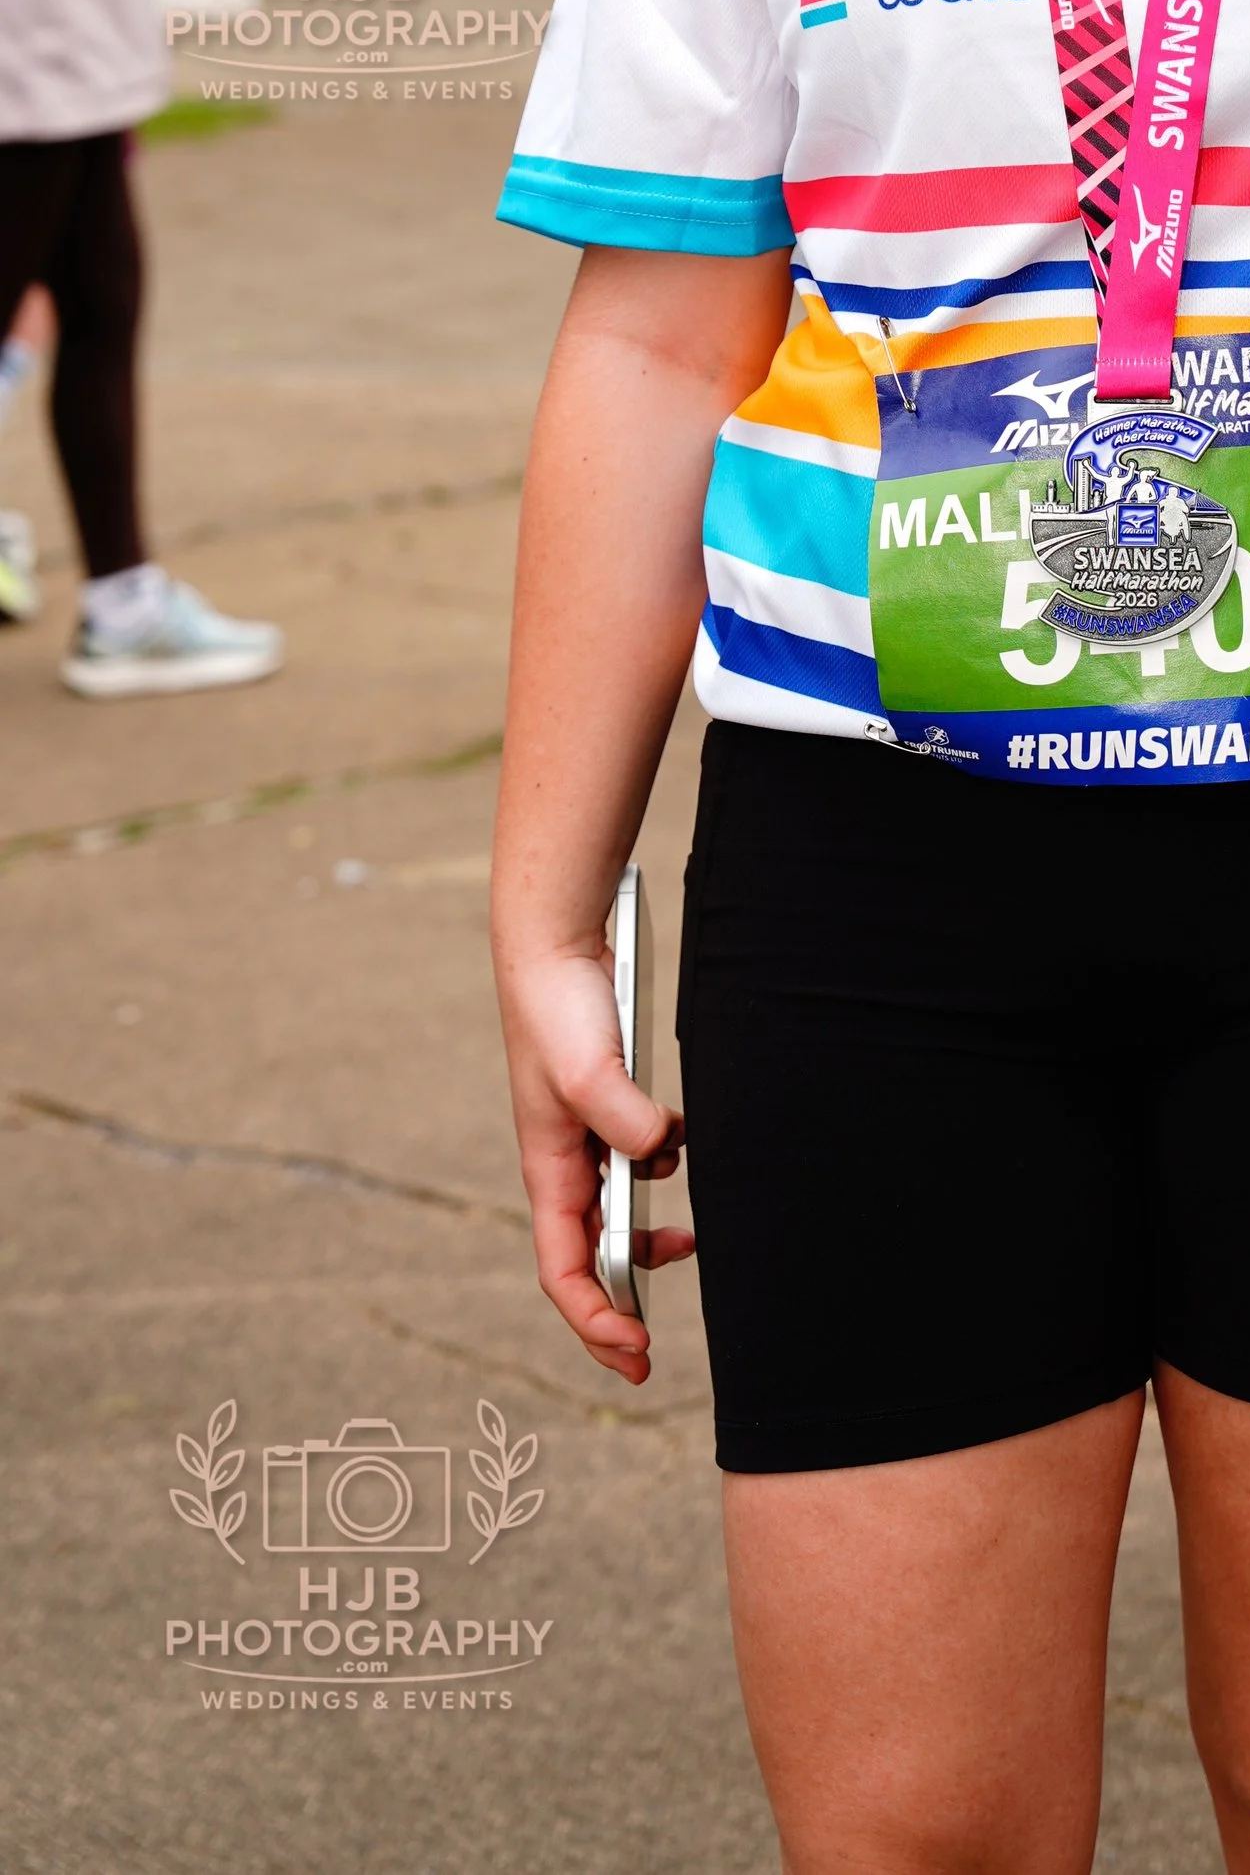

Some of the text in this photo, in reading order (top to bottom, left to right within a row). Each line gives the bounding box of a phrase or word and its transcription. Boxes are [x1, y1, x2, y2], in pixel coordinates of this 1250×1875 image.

[1095, 418, 1199, 443] Hanner Marathon
[1114, 432, 1175, 447] Abertawe
[1074, 547, 1202, 572] SWANSEA
[1115, 592, 1158, 608] 2026
[1054, 595, 1197, 636] #RUNSWANSEA
